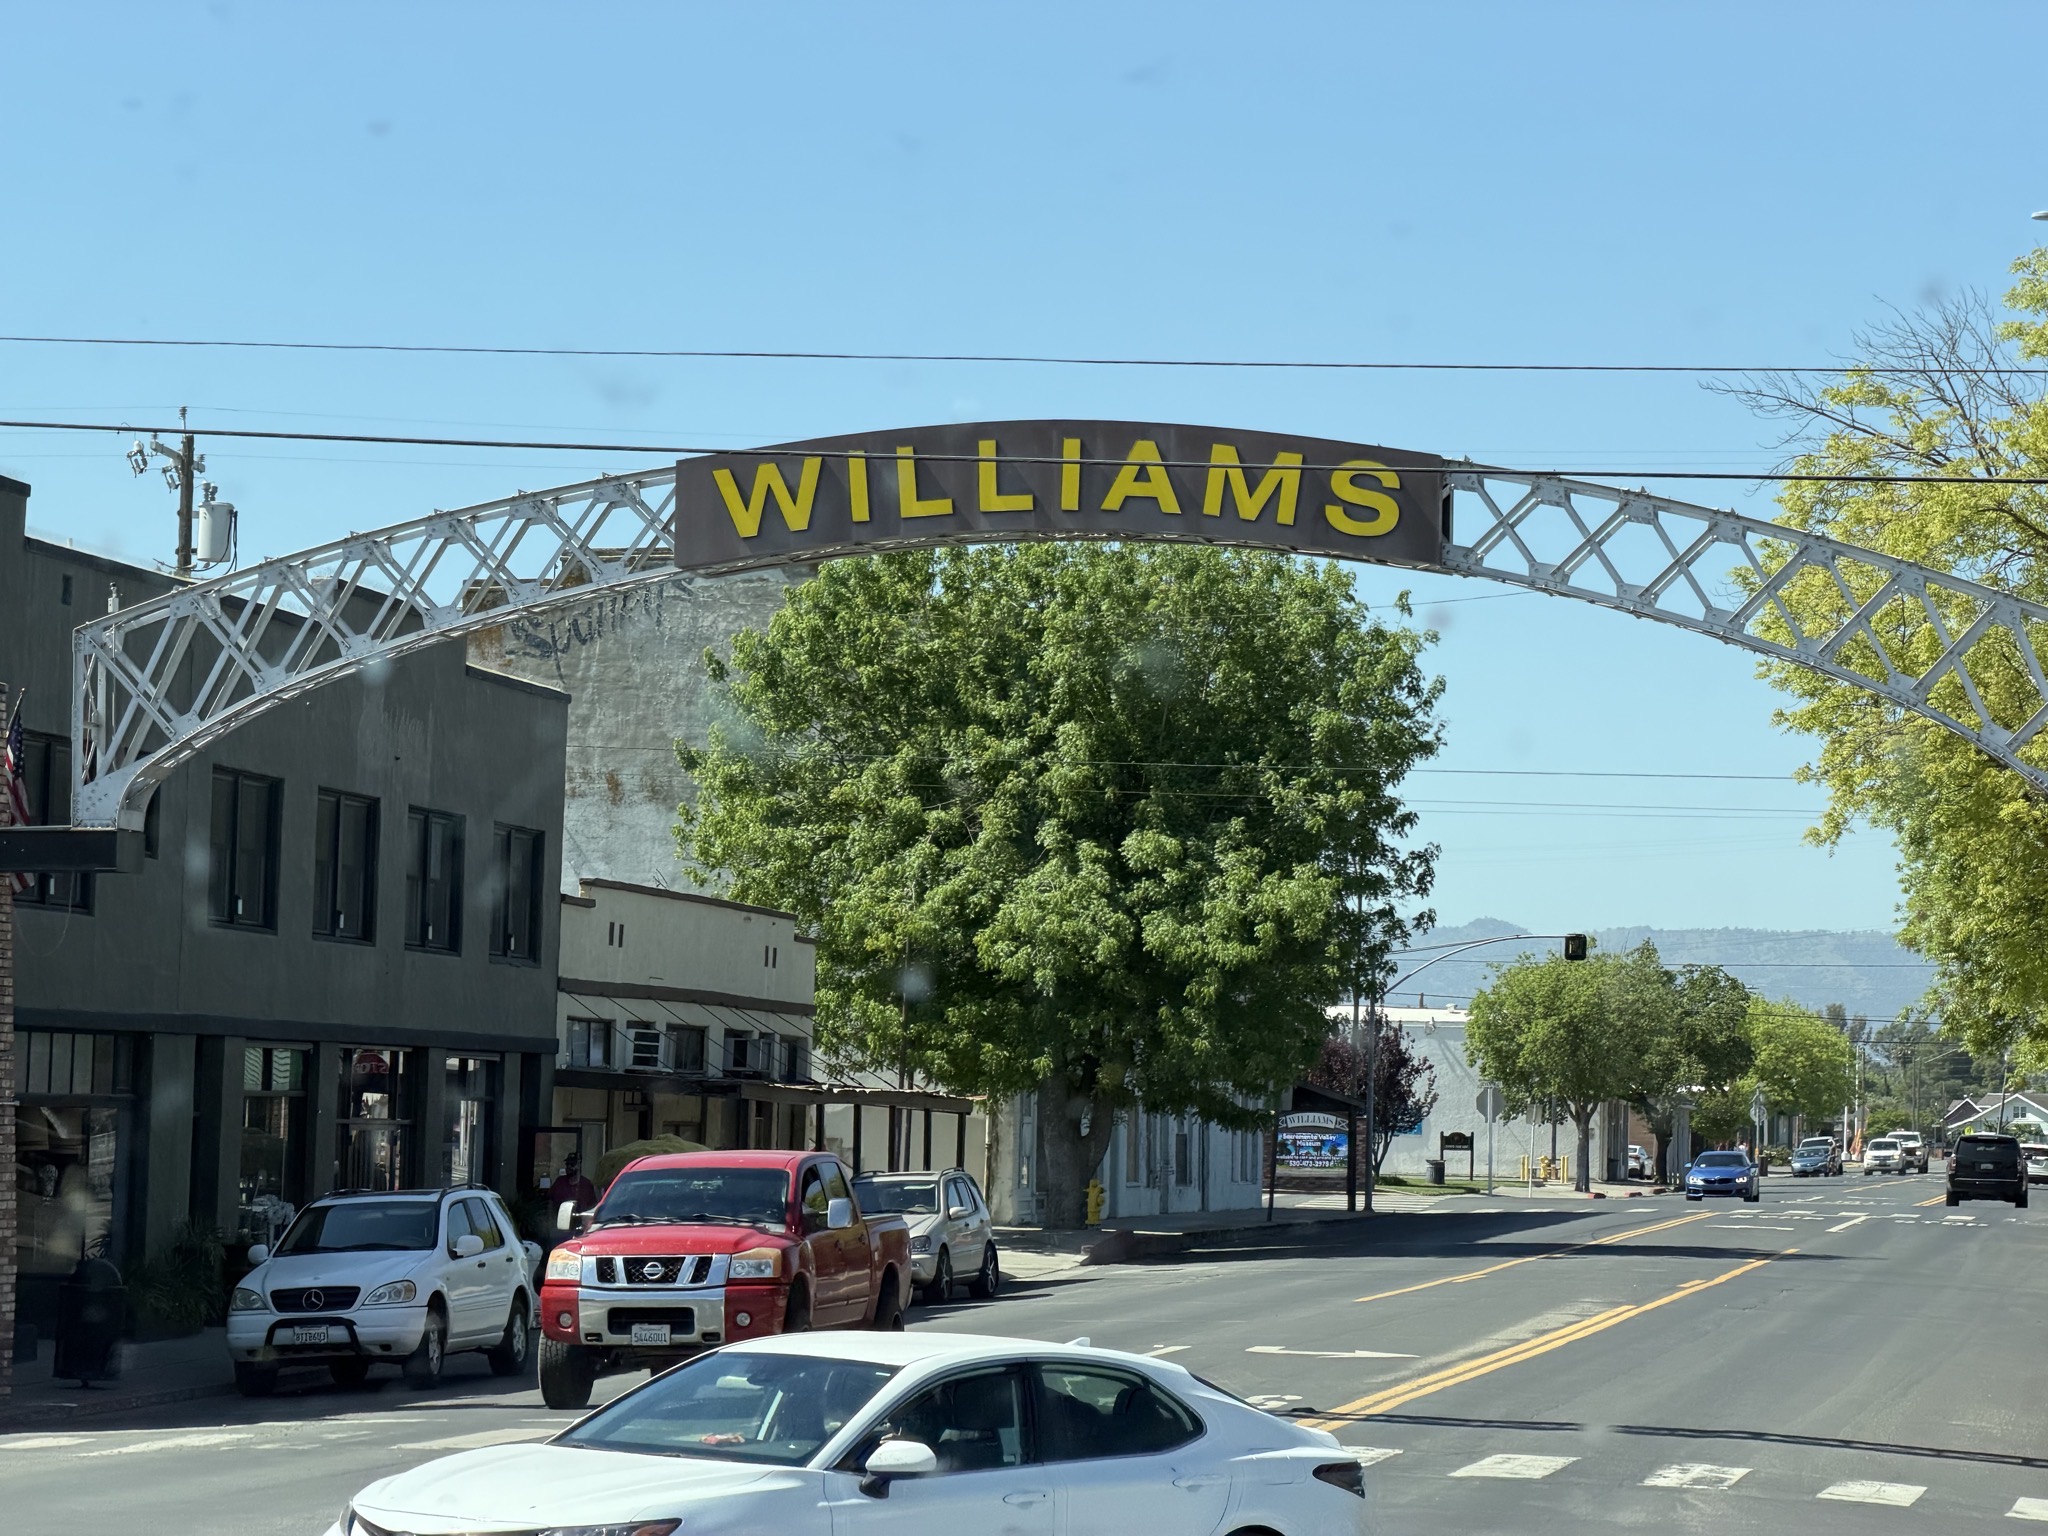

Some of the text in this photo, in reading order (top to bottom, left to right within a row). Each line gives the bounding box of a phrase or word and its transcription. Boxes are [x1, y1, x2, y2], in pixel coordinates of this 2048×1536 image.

[712, 437, 1401, 538] WILLIAMS
[1288, 1114, 1334, 1125] WILLIAMS
[1318, 1133, 1337, 1142] Valley
